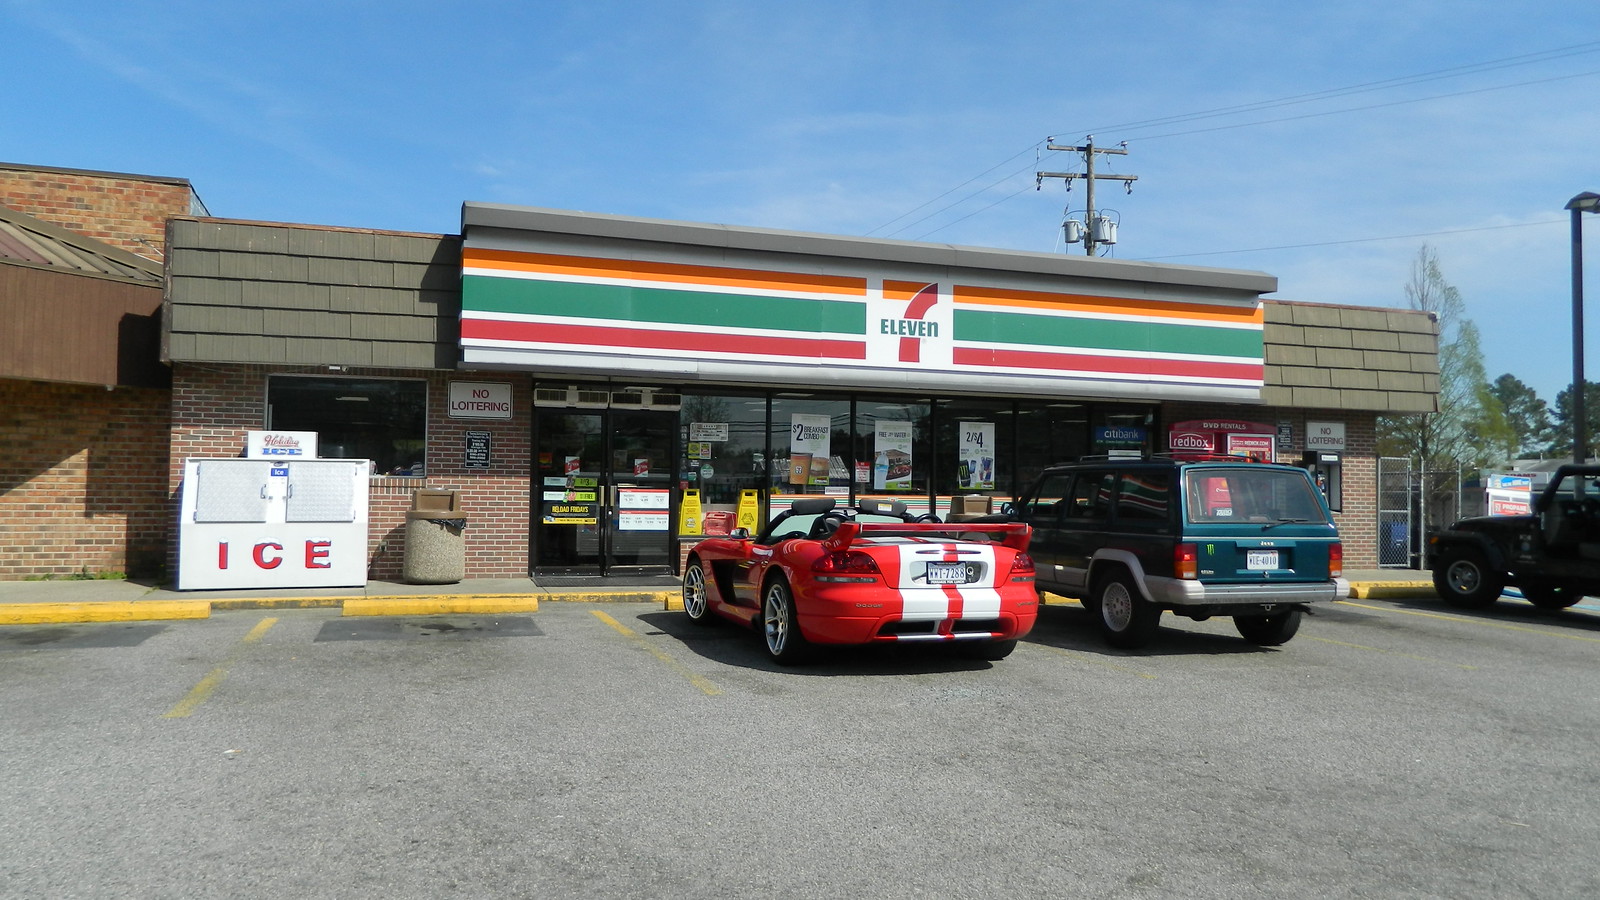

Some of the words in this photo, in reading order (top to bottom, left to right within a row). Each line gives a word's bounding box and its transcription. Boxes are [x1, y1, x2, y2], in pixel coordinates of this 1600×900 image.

[899, 283, 938, 362] 7
[472, 389, 490, 399] NO
[451, 401, 510, 412] LOITERING
[792, 424, 804, 441] $2
[1104, 429, 1139, 439] citibank
[1320, 427, 1331, 435] NO
[264, 434, 299, 447] Holiday
[966, 431, 984, 448] 2/$4
[1173, 436, 1209, 448] redbox
[1308, 436, 1344, 445] LOITERING
[262, 447, 303, 456] ICE
[219, 537, 332, 570] ICE
